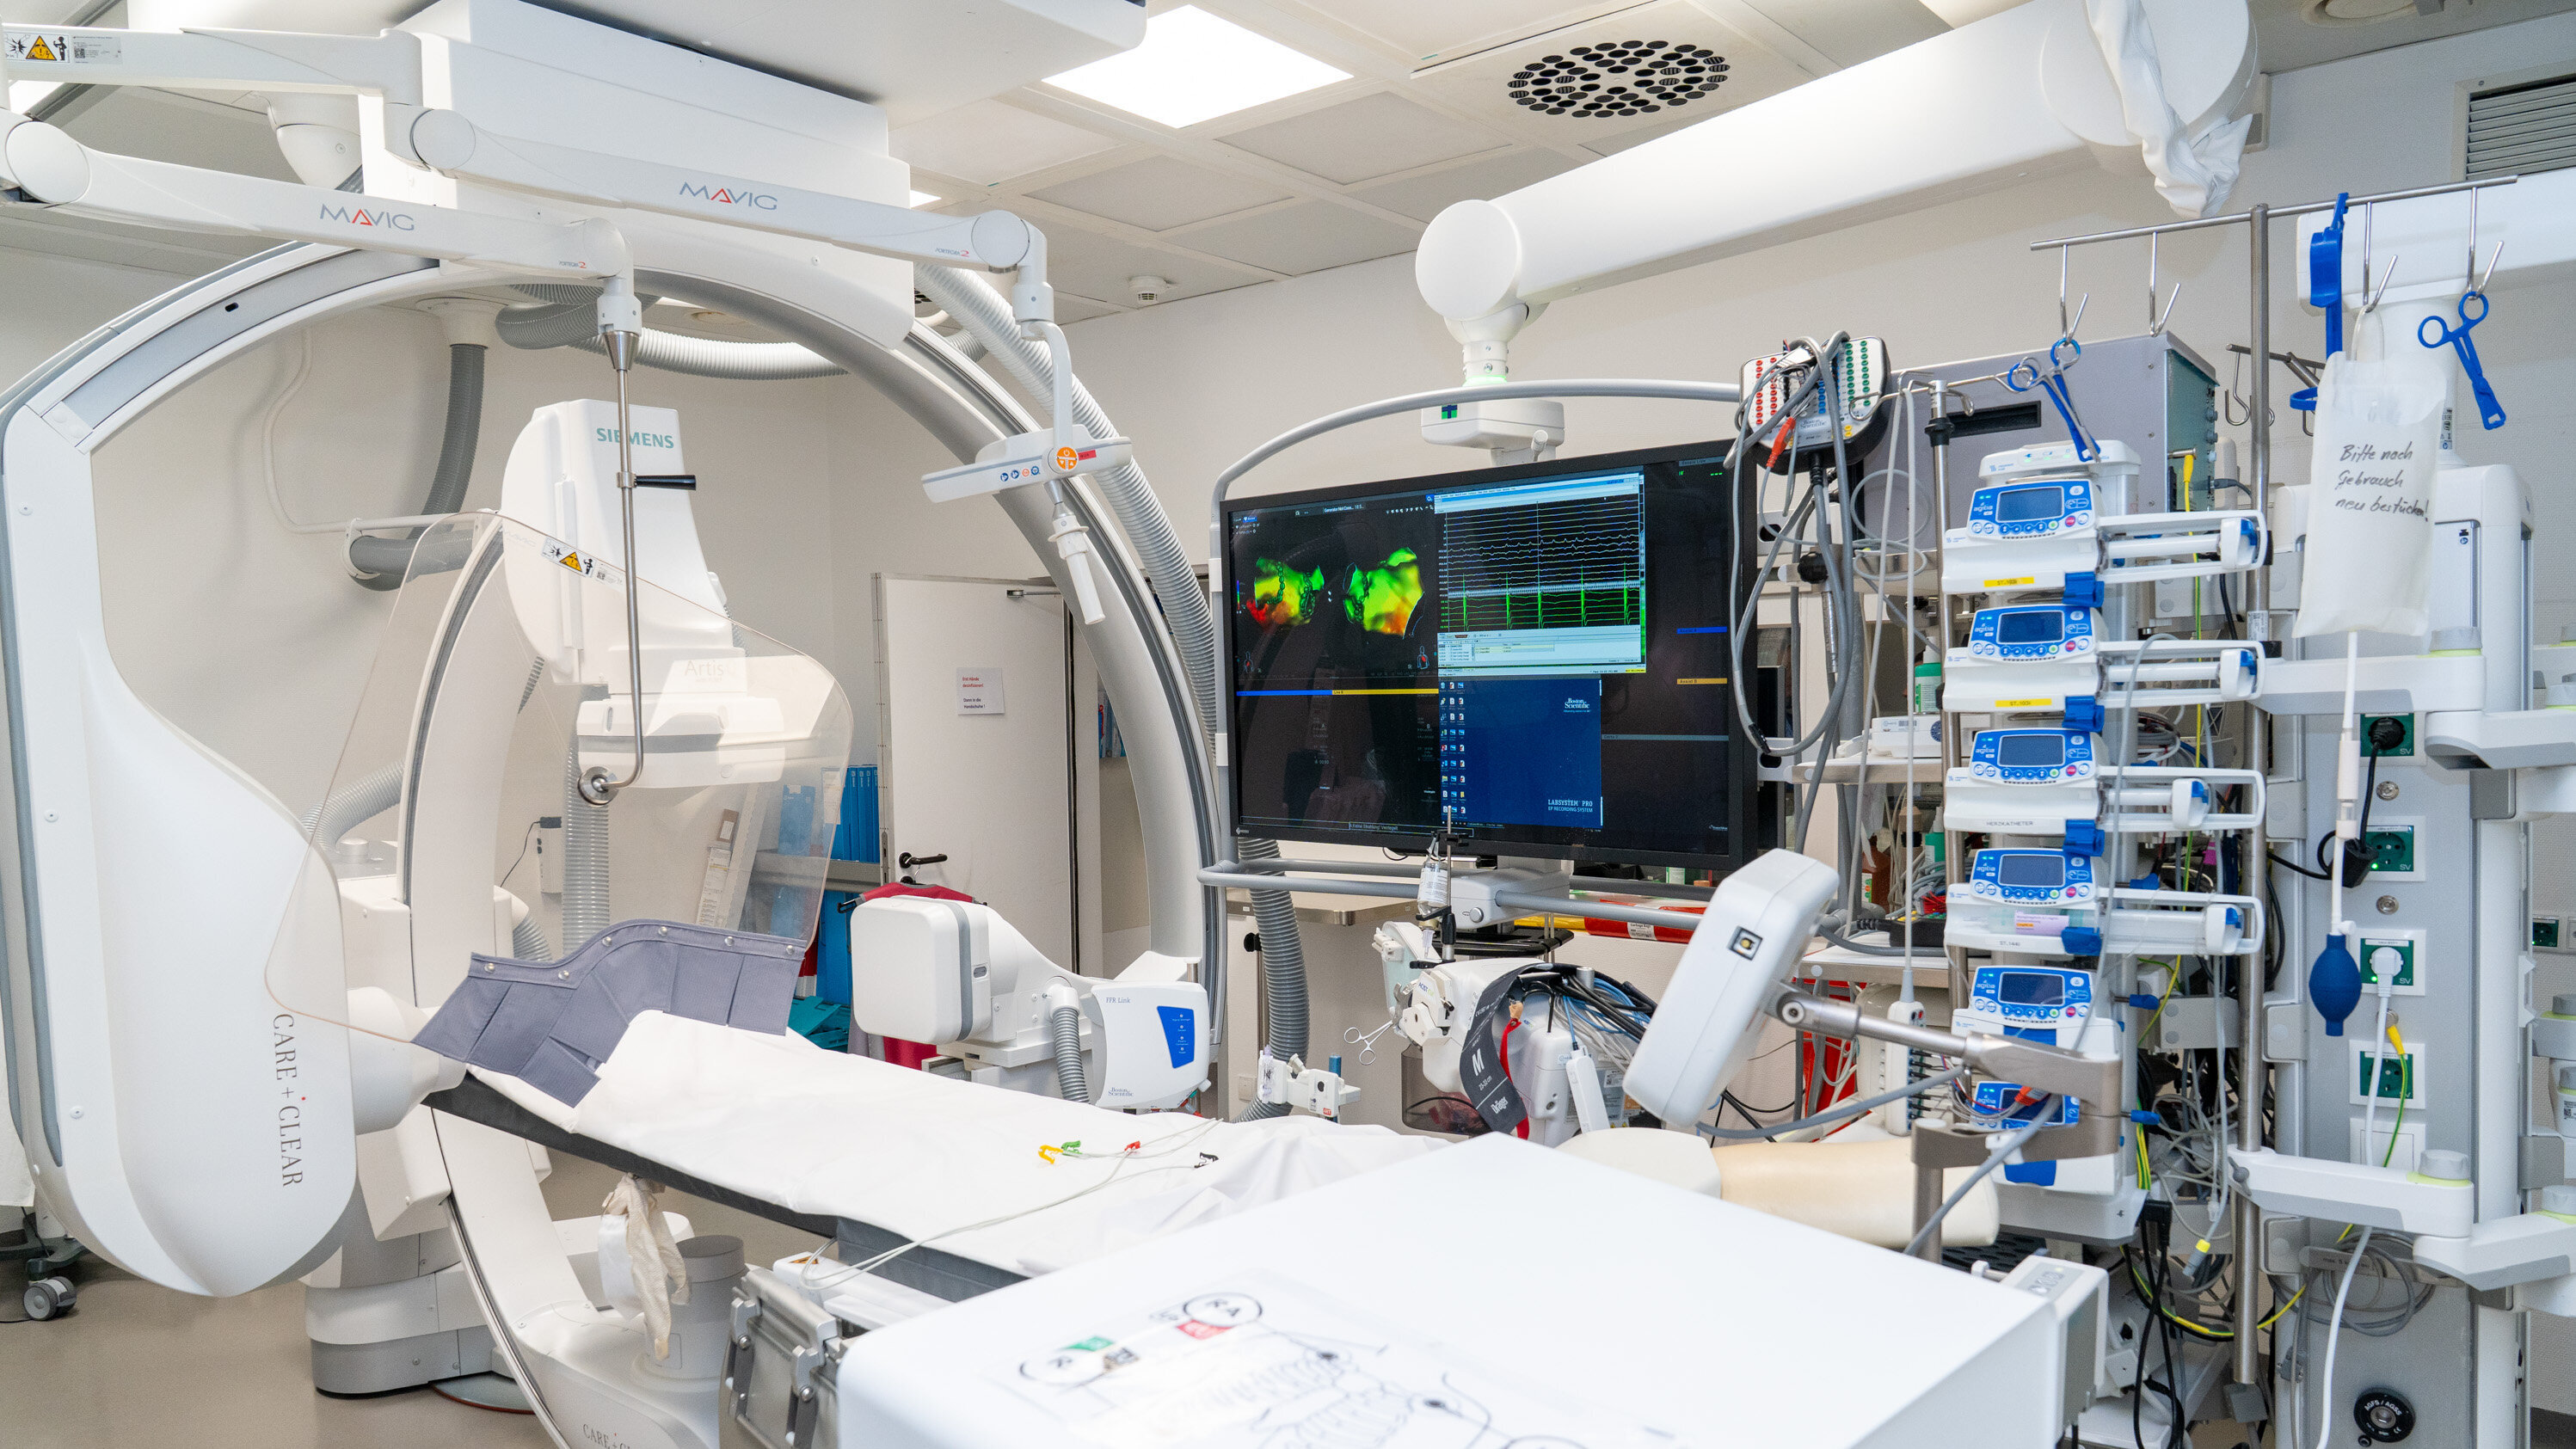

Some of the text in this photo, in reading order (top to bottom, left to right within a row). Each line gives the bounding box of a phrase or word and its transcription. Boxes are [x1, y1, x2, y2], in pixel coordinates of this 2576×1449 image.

[679, 181, 778, 211] MAVIG
[320, 203, 415, 231] MAVIG
[596, 427, 674, 449] SIEMENS
[2339, 444, 2376, 463] Bitte
[2334, 470, 2403, 490] Gebrauch
[2335, 497, 2365, 512] neu
[684, 659, 724, 677] Artis
[273, 1014, 298, 1081] CARE
[1472, 1047, 1485, 1076] M
[1491, 1096, 1509, 1114] Dräger
[279, 1105, 304, 1188] CLEAR
[583, 1423, 610, 1449] CARE
